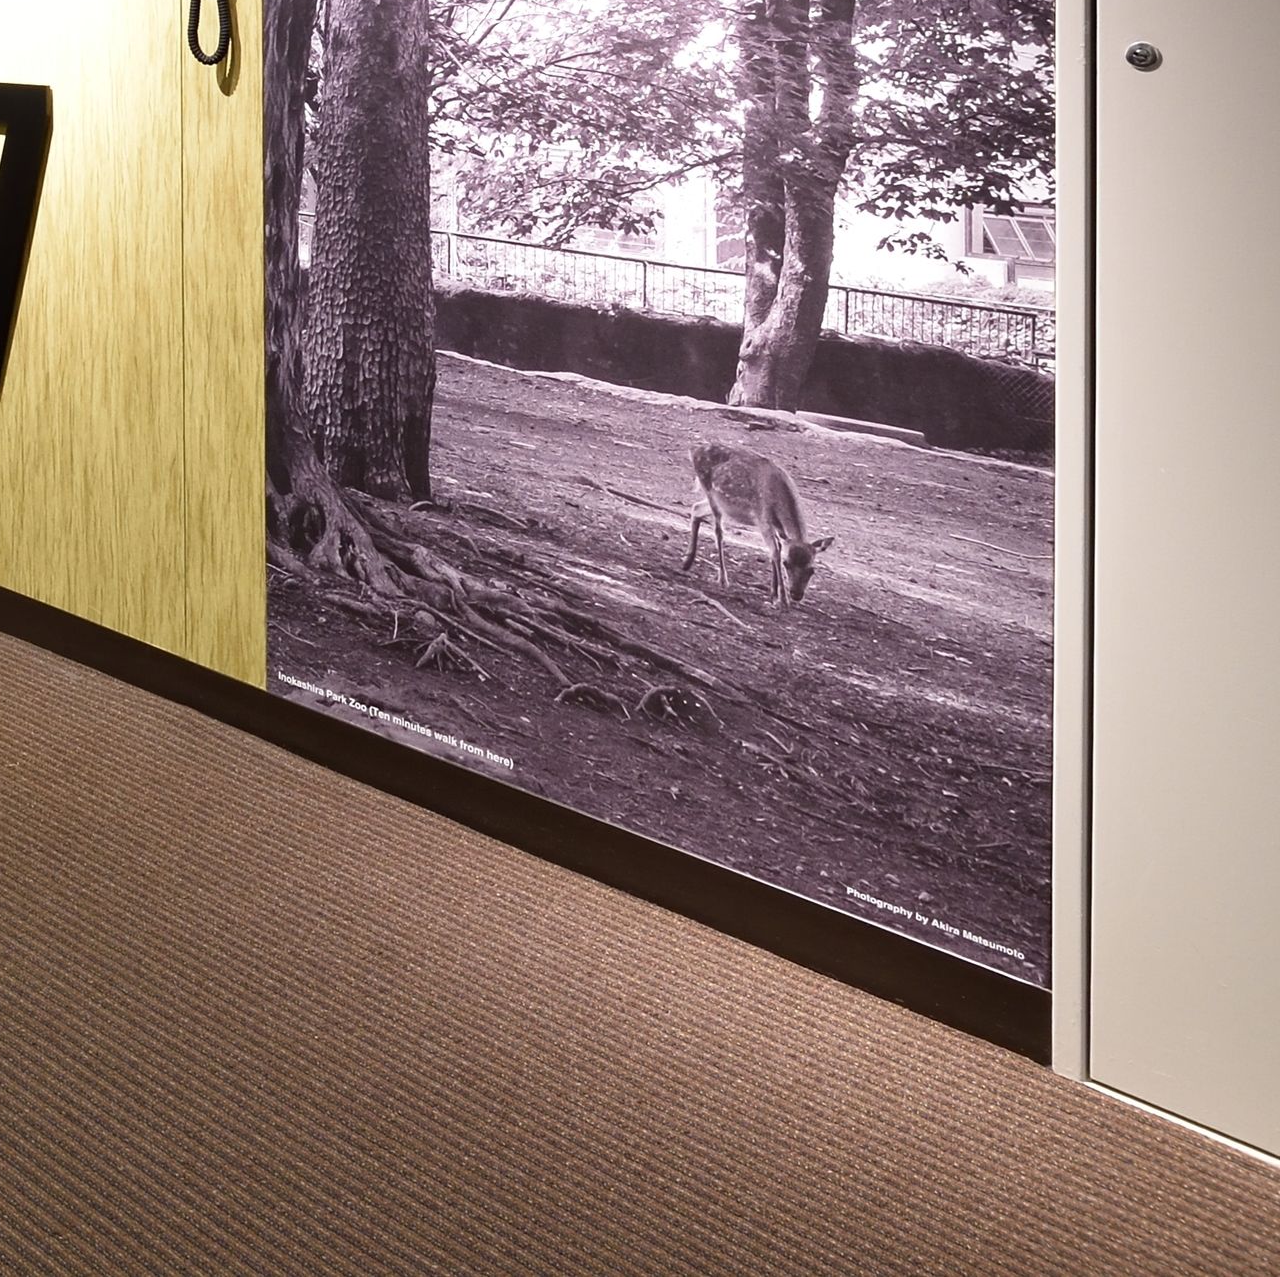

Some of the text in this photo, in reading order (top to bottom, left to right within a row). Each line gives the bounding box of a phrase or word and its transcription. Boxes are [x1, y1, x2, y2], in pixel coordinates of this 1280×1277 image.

[278, 671, 515, 770] Inokashira Park Zoo (Ten minutes walk from here)
[846, 886, 1025, 961] Photography by Akira Matsumoto
